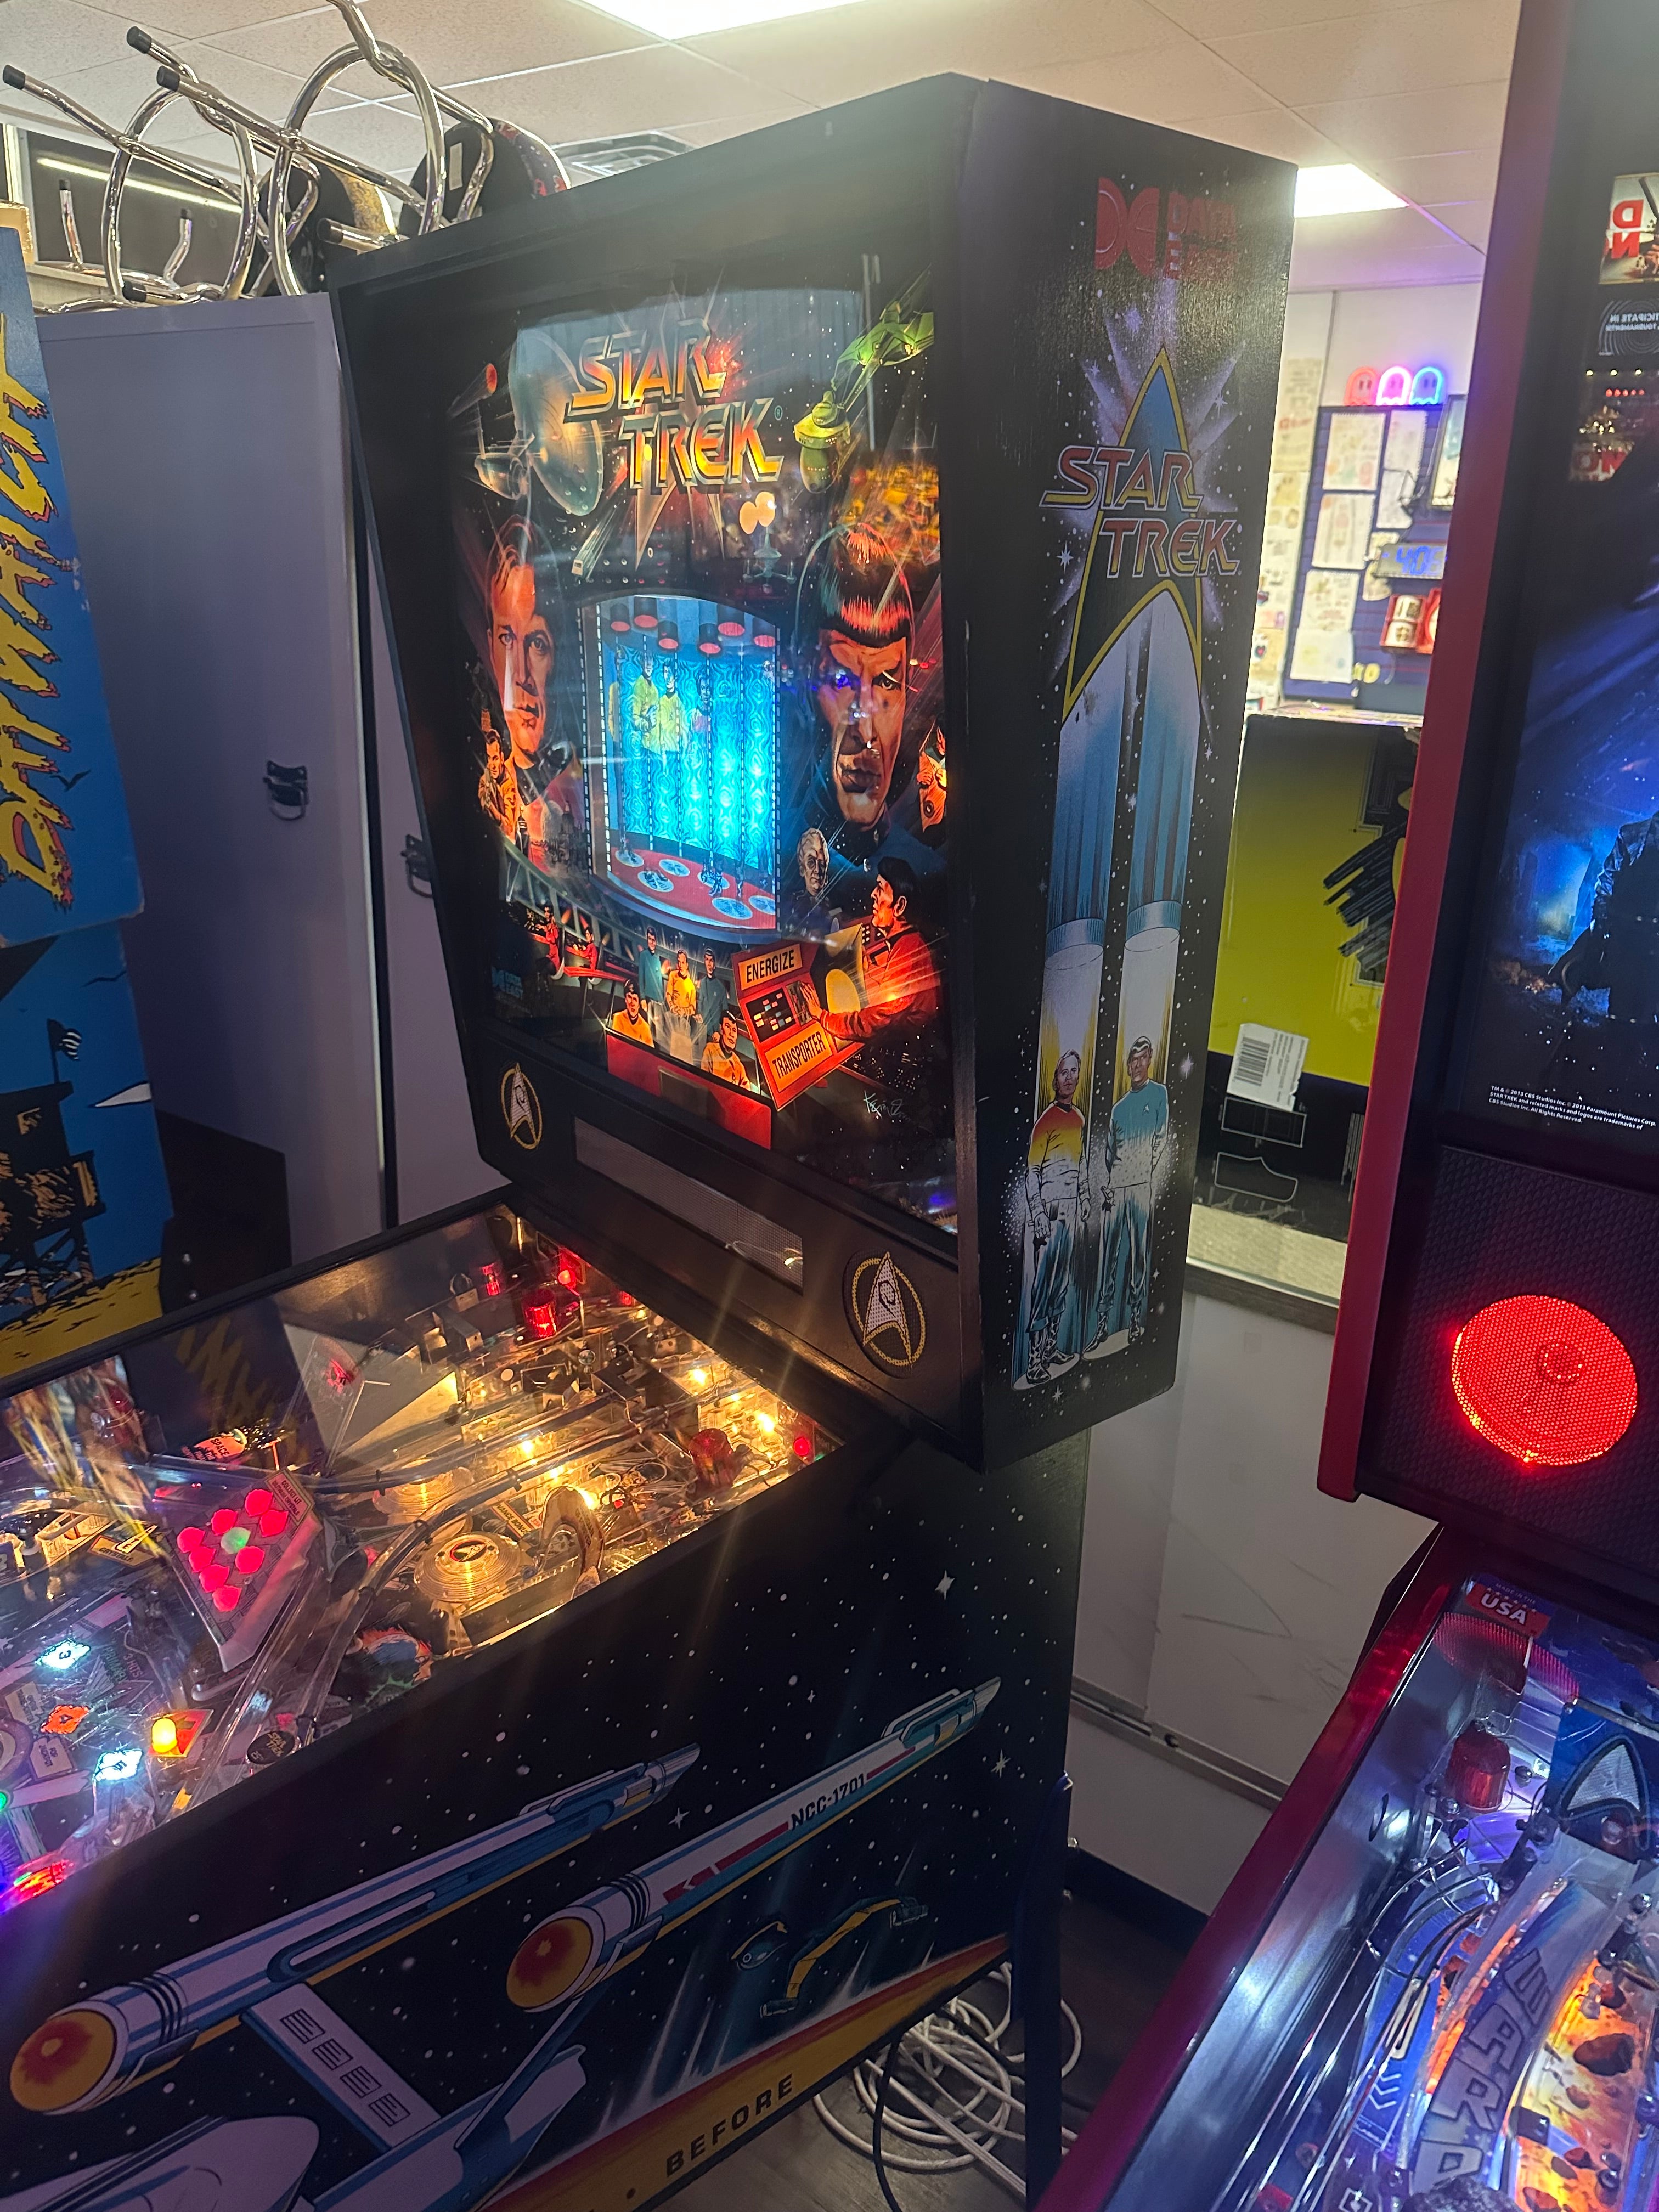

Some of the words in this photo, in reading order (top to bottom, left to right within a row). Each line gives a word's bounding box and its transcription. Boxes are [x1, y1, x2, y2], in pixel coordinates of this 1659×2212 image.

[564, 317, 727, 423] STAR
[619, 397, 785, 489] TREK
[1039, 445, 1203, 511] STAR
[1099, 518, 1240, 578] TREK
[747, 950, 794, 983] ENERGIZE
[772, 1031, 826, 1079] TRANSPORTER
[1500, 1100, 1520, 1109] Studios
[1539, 1109, 1555, 1117] Rights
[1556, 1113, 1583, 1124] Reserved.
[1530, 1101, 1548, 1109] related
[1578, 1110, 1593, 1119] logos
[1604, 1117, 1635, 1128] trademarks
[1536, 1095, 1556, 1104] Studios
[1587, 1106, 1617, 1118] Paramount
[1618, 1113, 1640, 1122] Pictures
[1641, 1119, 1656, 1127] Corp.
[281, 1480, 295, 1498] COLLECT
[285, 1497, 300, 1516] CRYSTALS
[1481, 1593, 1526, 1624] USA
[791, 1773, 864, 1831] NCC-1701
[667, 2073, 792, 2177] BEFORE
